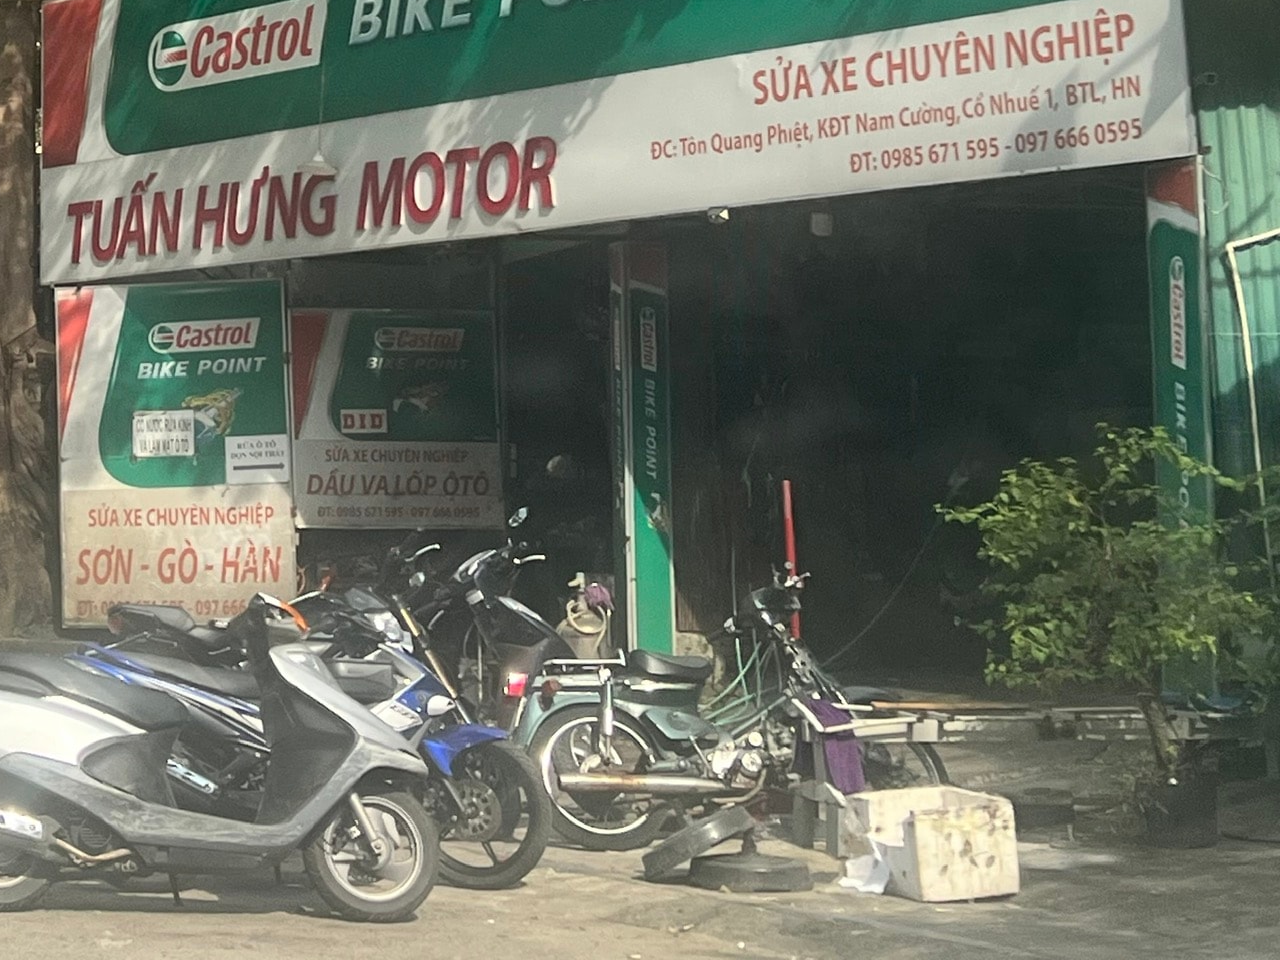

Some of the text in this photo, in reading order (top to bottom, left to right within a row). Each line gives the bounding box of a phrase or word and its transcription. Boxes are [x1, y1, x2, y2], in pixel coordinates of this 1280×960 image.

[190, 4, 315, 79] Castrol
[752, 8, 1135, 106] SỬA XE CHUYÊN NGHIỆP
[650, 139, 677, 160] ĐC:
[679, 136, 707, 157] Tôn
[711, 132, 763, 153] Quang
[767, 121, 813, 148] Phiệt,
[817, 115, 851, 139] KĐT
[856, 113, 895, 134] Nam
[990, 85, 1039, 116] Nhuế
[1066, 81, 1107, 107] BTL,
[1111, 74, 1142, 100] HN
[850, 151, 878, 173] ĐT:
[881, 146, 923, 170] 0985
[928, 142, 960, 164] 671
[966, 137, 1000, 160] 595
[1015, 130, 1049, 153] 097
[1055, 126, 1090, 149] 666
[1094, 118, 1142, 145] 0595
[67, 136, 559, 265] TUẤN HƯNG MOTOR
[176, 321, 252, 349] Castrol
[137, 356, 267, 379] BIKE POINT
[342, 413, 384, 430] DID
[353, 448, 368, 463] XE
[646, 425, 657, 480] POINT
[88, 503, 118, 527] SỬA
[123, 508, 142, 526] XE
[214, 502, 274, 529] NGHIỆP
[76, 545, 133, 586] SƠN
[157, 538, 198, 584] GÒ
[221, 538, 282, 583] HÀN
